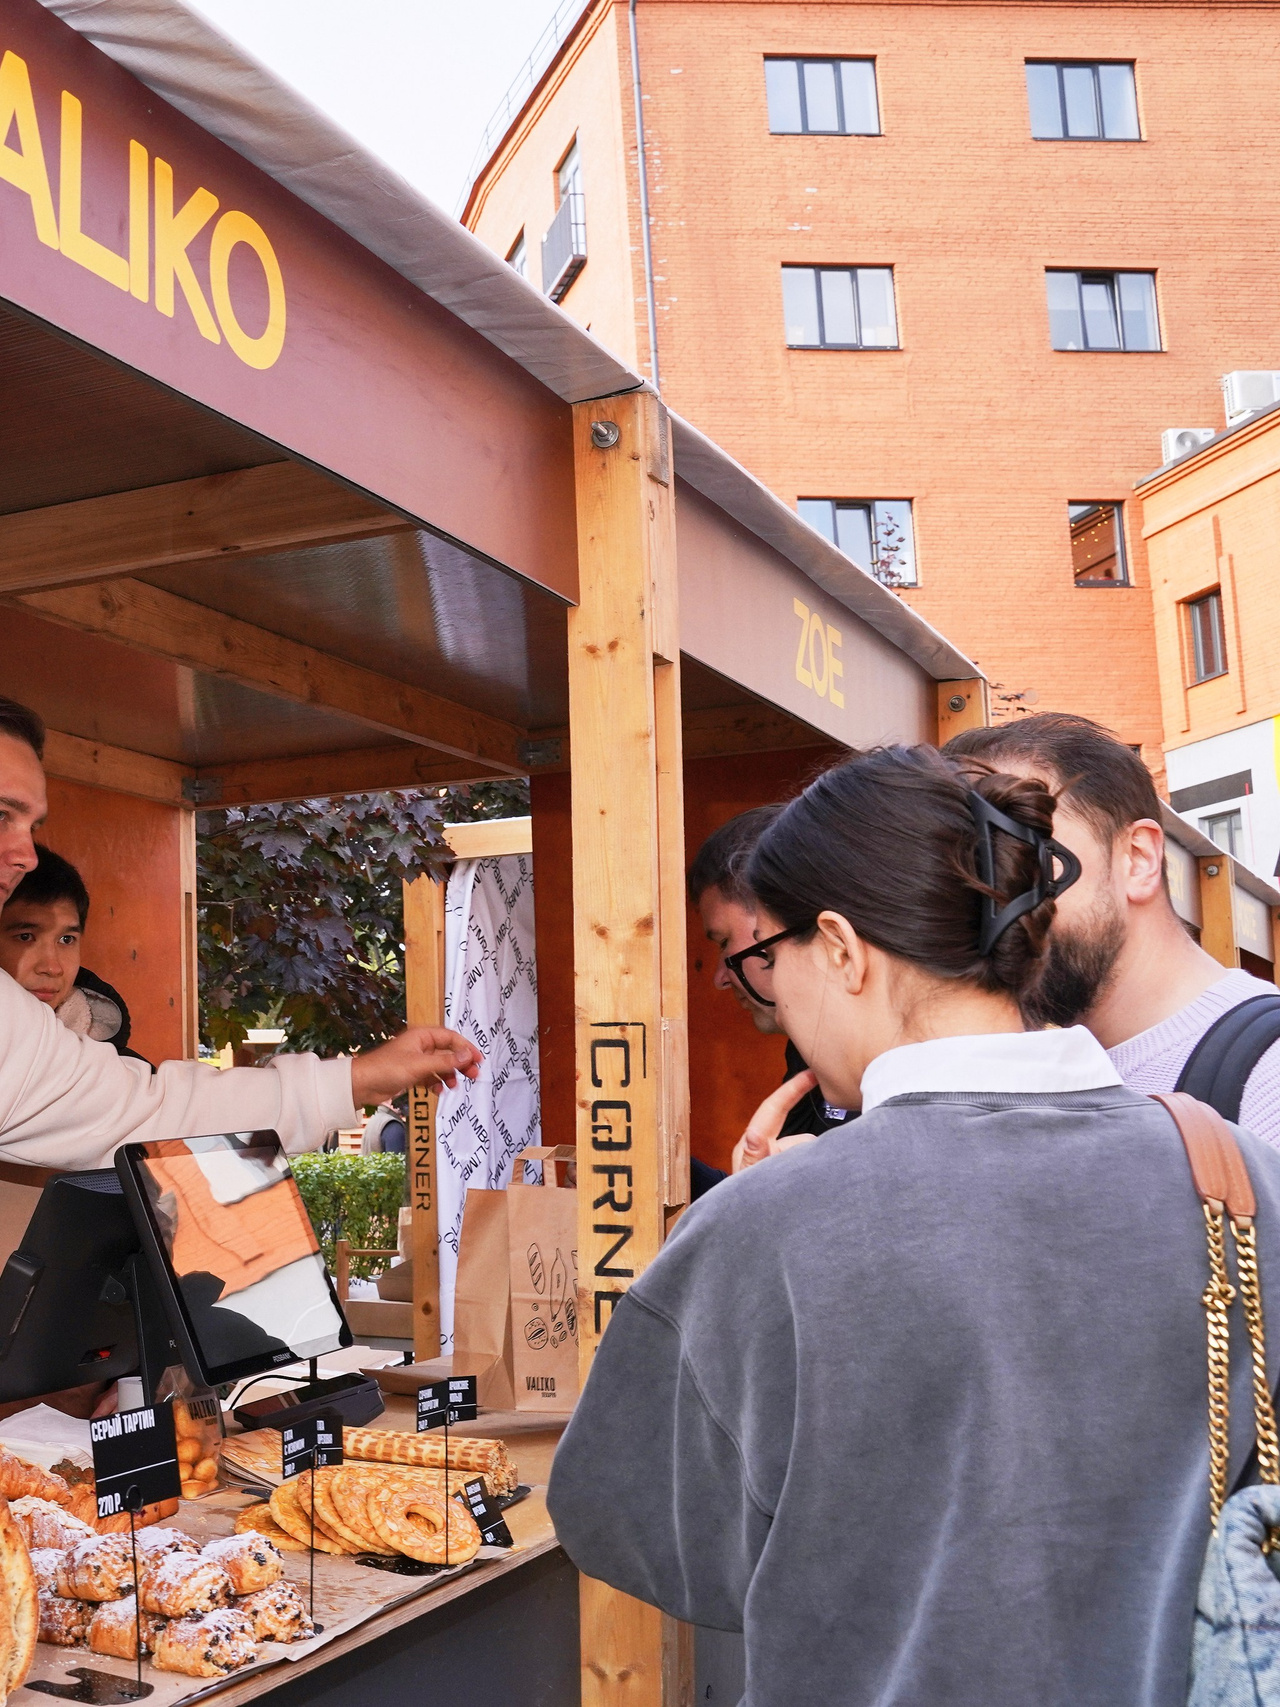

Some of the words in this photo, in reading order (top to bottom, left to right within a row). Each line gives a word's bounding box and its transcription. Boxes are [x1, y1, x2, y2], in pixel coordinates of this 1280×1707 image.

[793, 597, 844, 709] ZOE
[590, 1038, 634, 1352] CORNE
[525, 1376, 556, 1392] VALIKO
[91, 1413, 123, 1442] СЕРЫЙ
[122, 1408, 156, 1434] ТАРТИН
[187, 1399, 218, 1421] VALIKO
[97, 1494, 115, 1518] 270
[114, 1492, 124, 1512] Р.
